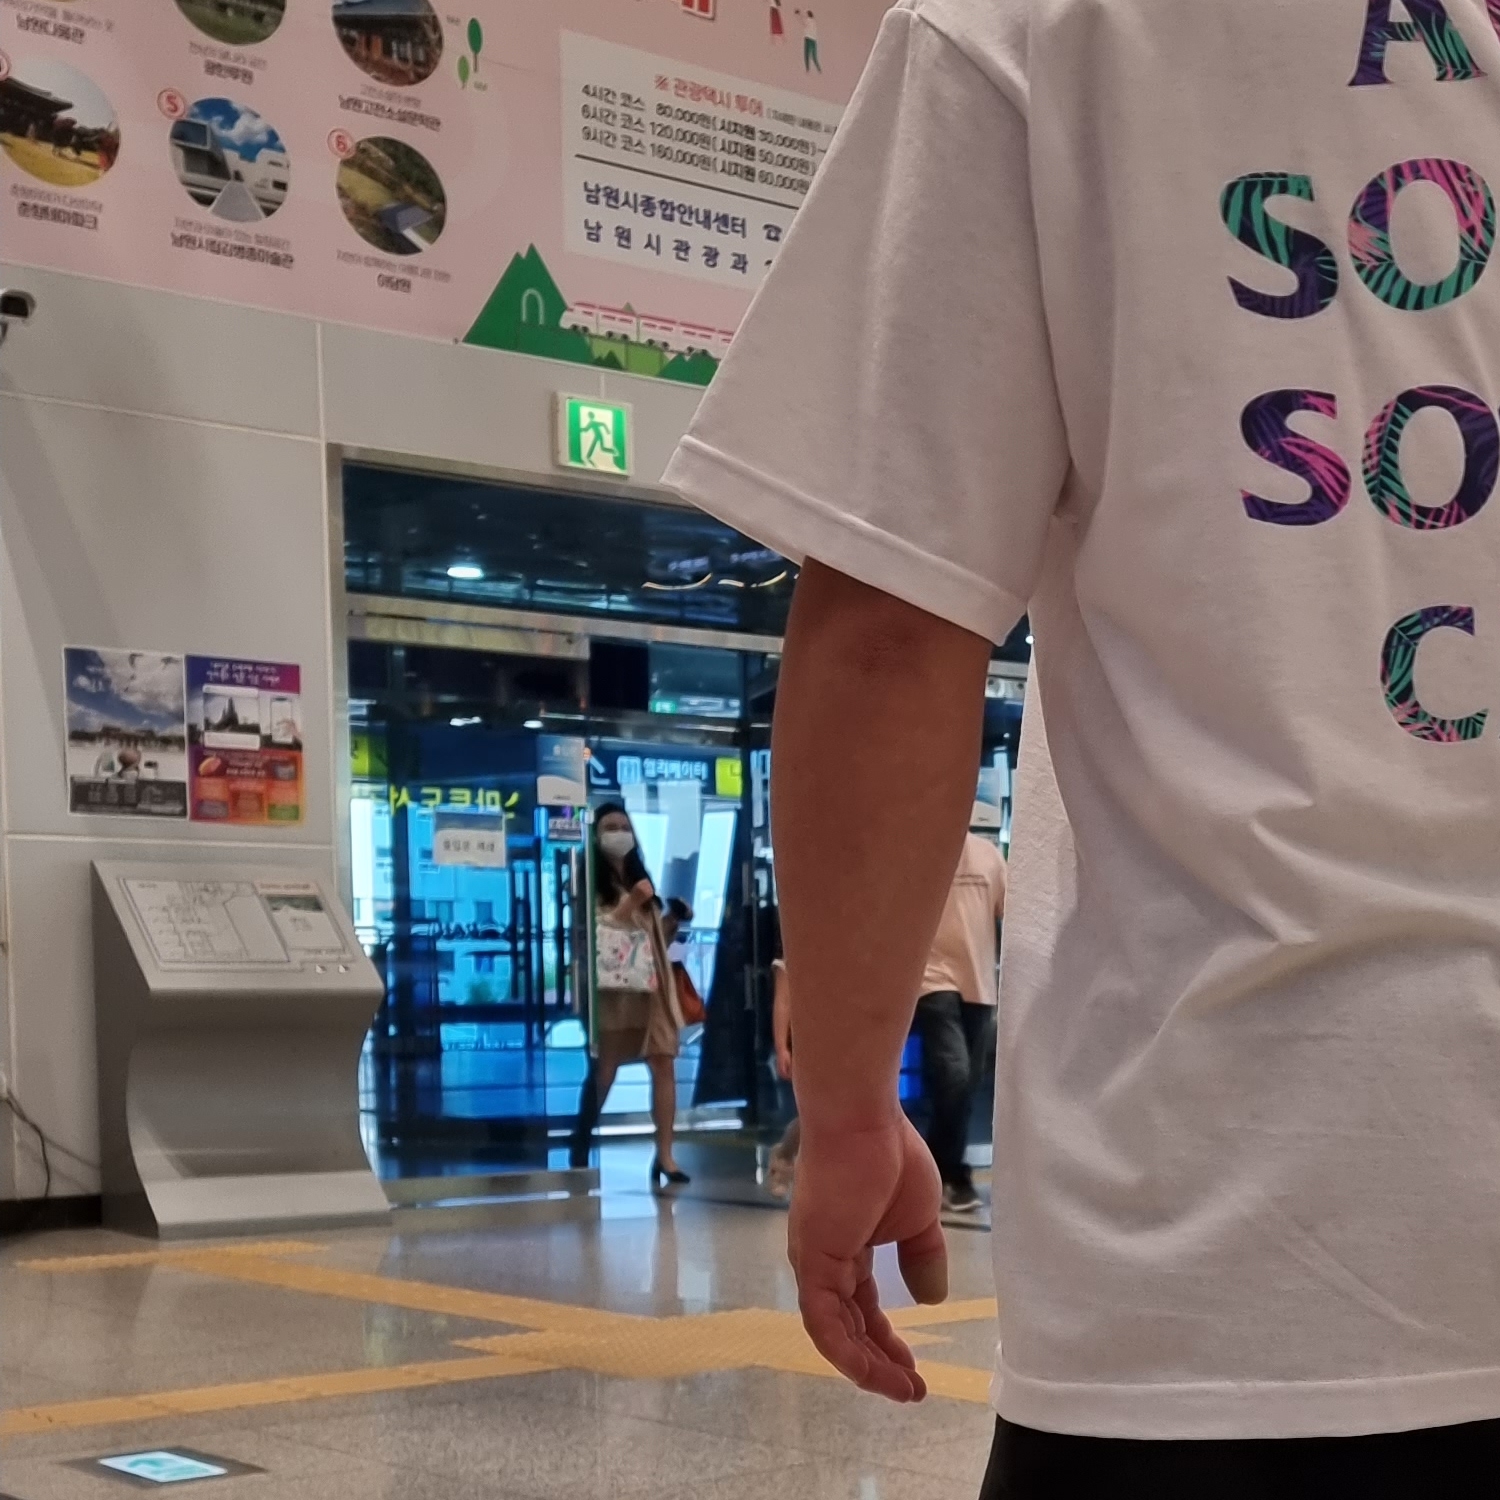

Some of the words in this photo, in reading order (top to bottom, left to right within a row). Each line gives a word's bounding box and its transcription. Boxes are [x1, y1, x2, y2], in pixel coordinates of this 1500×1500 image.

[581, 84, 617, 103] 4시간
[620, 92, 645, 111] 코스
[581, 103, 617, 126] 6시간
[620, 113, 646, 133] 코스
[620, 134, 646, 155] 코스
[583, 181, 747, 238] 남원시종합안내센터
[643, 757, 709, 780] 엘리베이터
